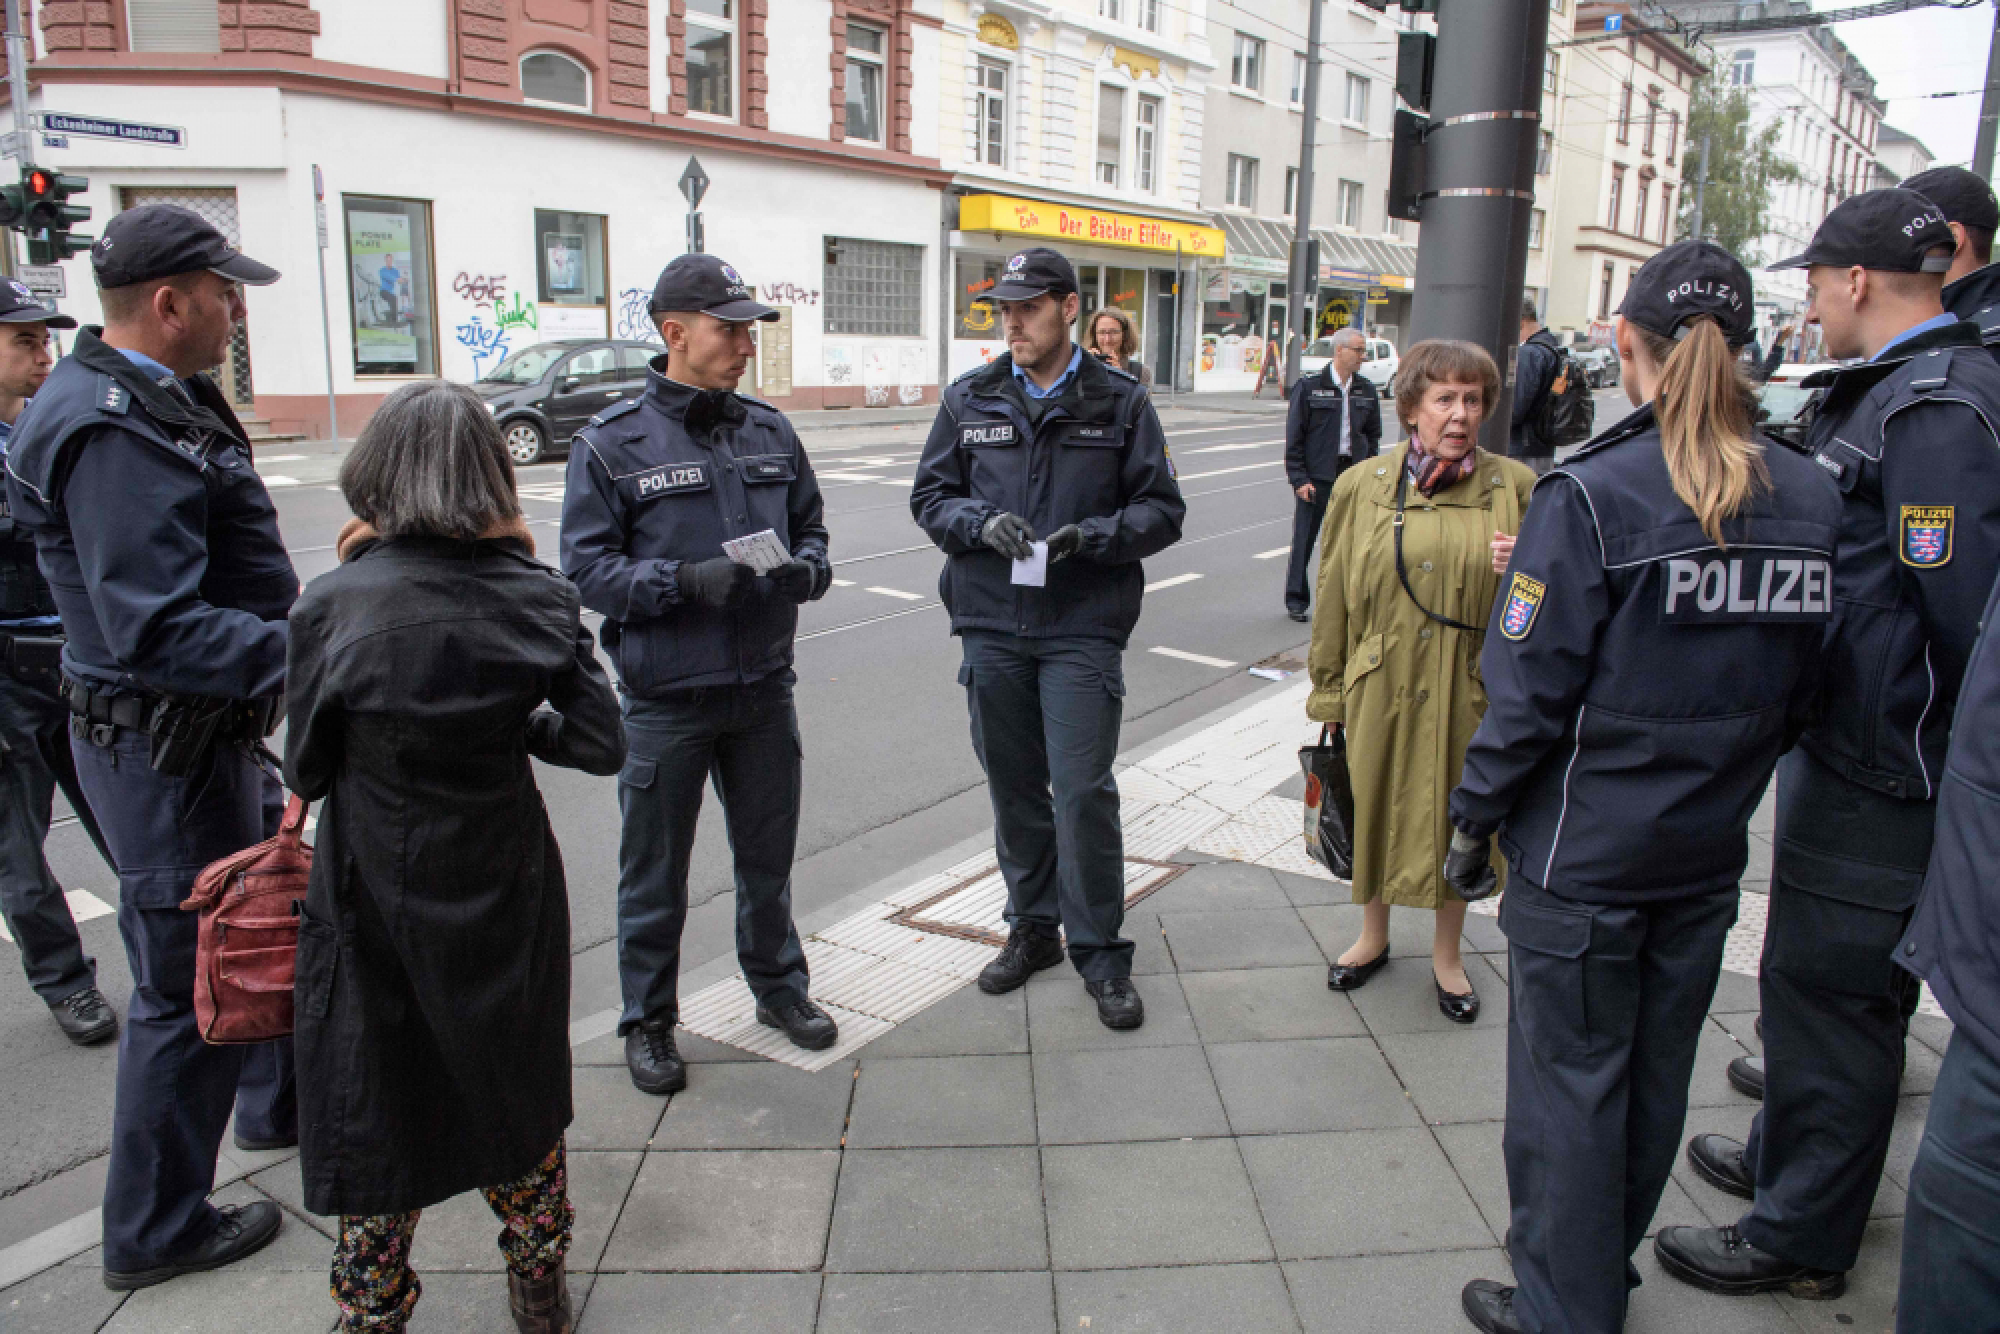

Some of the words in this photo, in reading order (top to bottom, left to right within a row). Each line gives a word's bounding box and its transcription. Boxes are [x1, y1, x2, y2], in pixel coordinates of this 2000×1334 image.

[1060, 210, 1083, 236] Der
[1090, 214, 1133, 243] Bäcker
[1139, 222, 1173, 248] Eifler
[1668, 279, 1743, 312] POLIZEI
[963, 425, 1013, 444] POLIZEI
[639, 468, 704, 495] POLIZEI
[1903, 508, 1952, 519] POLIZEI
[1665, 559, 1832, 615] POLIZEI
